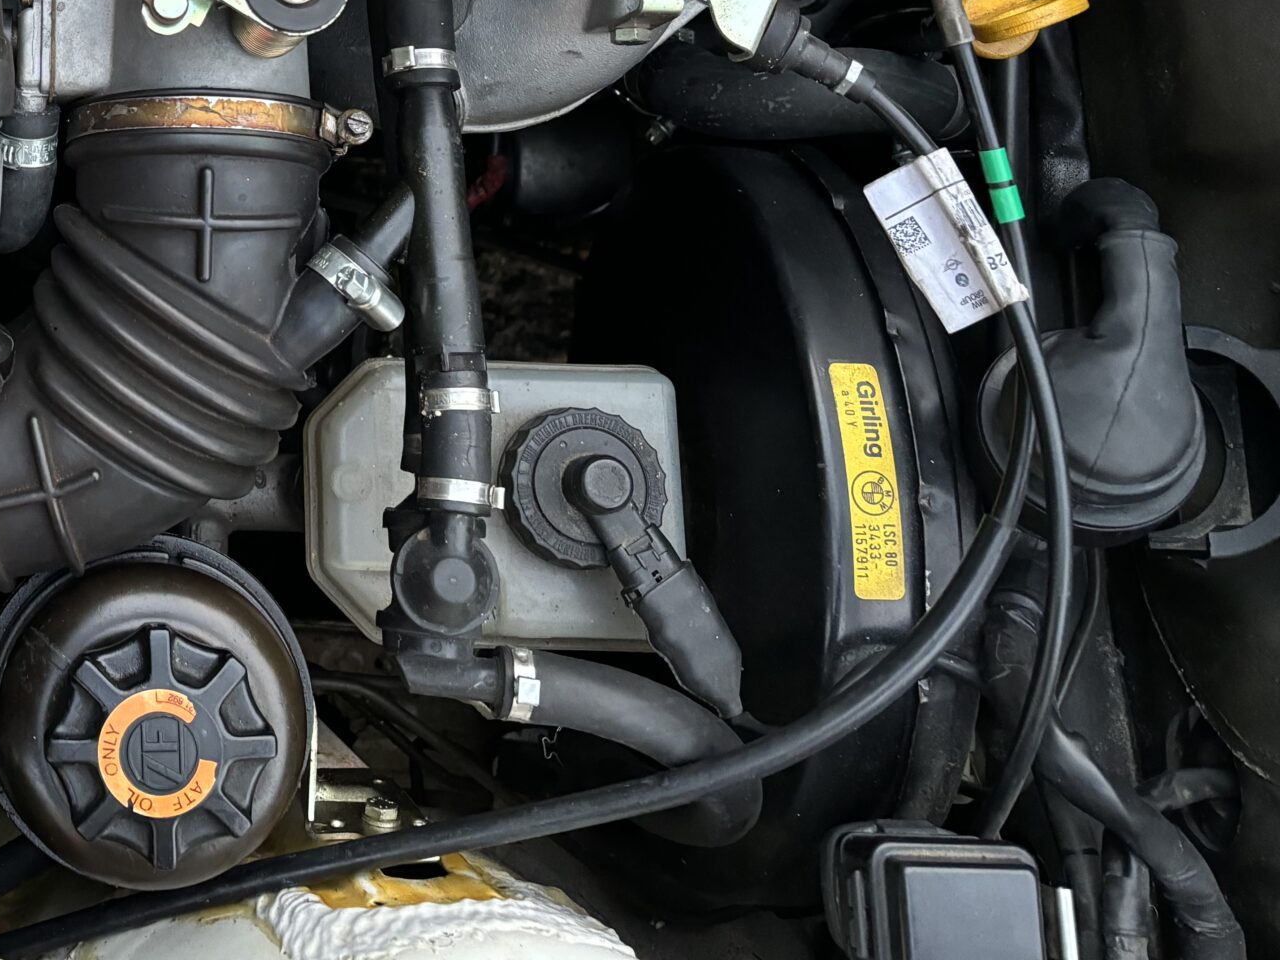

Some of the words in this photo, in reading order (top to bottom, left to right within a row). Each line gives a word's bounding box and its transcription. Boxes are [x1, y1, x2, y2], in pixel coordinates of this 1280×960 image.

[960, 289, 986, 307] GROUP
[972, 296, 989, 311] BMW
[855, 380, 884, 459] Girling
[876, 476, 893, 512] BMW
[883, 524, 897, 546] LSC
[855, 524, 869, 581] 1157911
[884, 551, 899, 568] 80
[102, 723, 120, 776] ONLY
[140, 720, 187, 785] ZF
[127, 787, 153, 812] OIL
[172, 781, 203, 812] ATF
